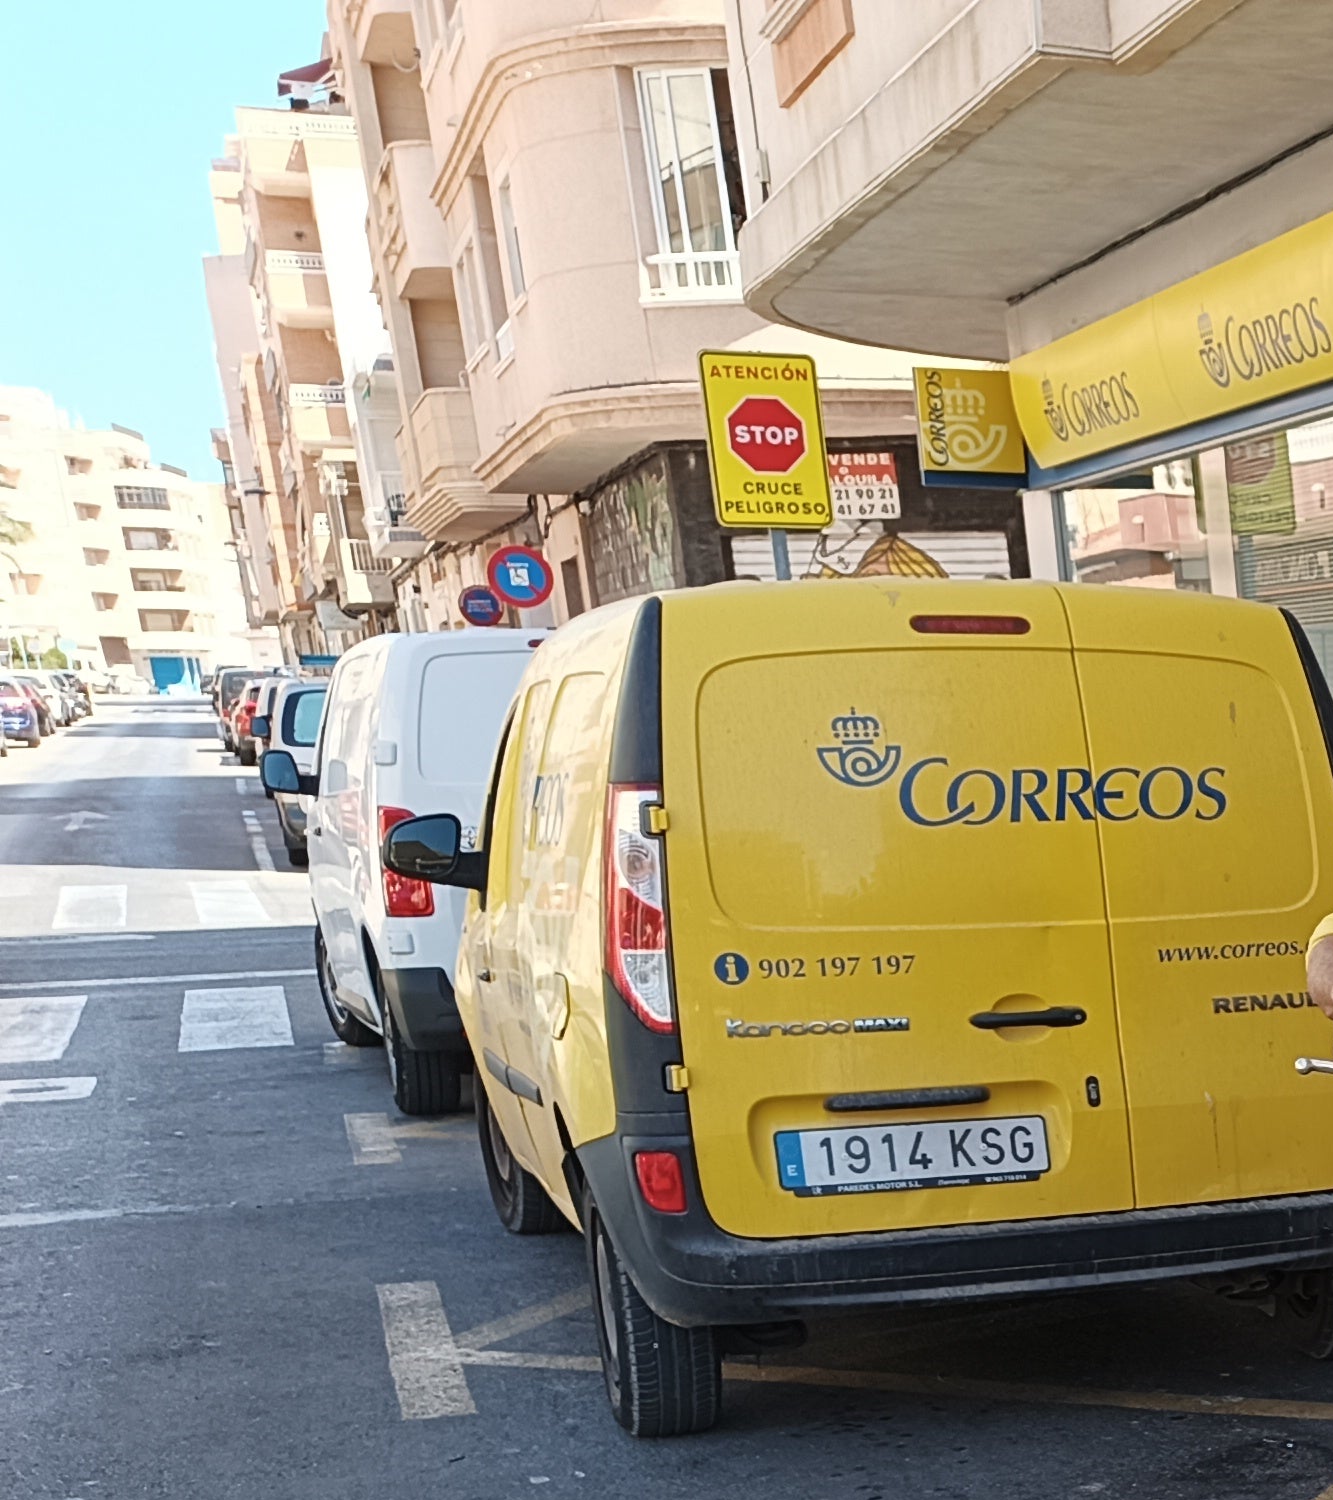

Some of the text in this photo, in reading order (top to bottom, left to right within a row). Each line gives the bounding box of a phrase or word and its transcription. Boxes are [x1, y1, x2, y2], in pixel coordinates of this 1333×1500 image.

[1224, 296, 1332, 381] CORREOS
[709, 362, 809, 382] ATENCIÓN
[734, 424, 799, 446] STOP
[828, 452, 891, 466] VENDE
[743, 481, 804, 496] CRUCE
[835, 487, 894, 500] 21 90 21
[724, 501, 827, 515] PELIGROSO
[898, 756, 1227, 827] CORREOS
[758, 954, 916, 979] 902 197 197
[1211, 992, 1319, 1014] RENAUL
[818, 1125, 1035, 1176] 1914 KSG
[787, 1164, 798, 1177] E
